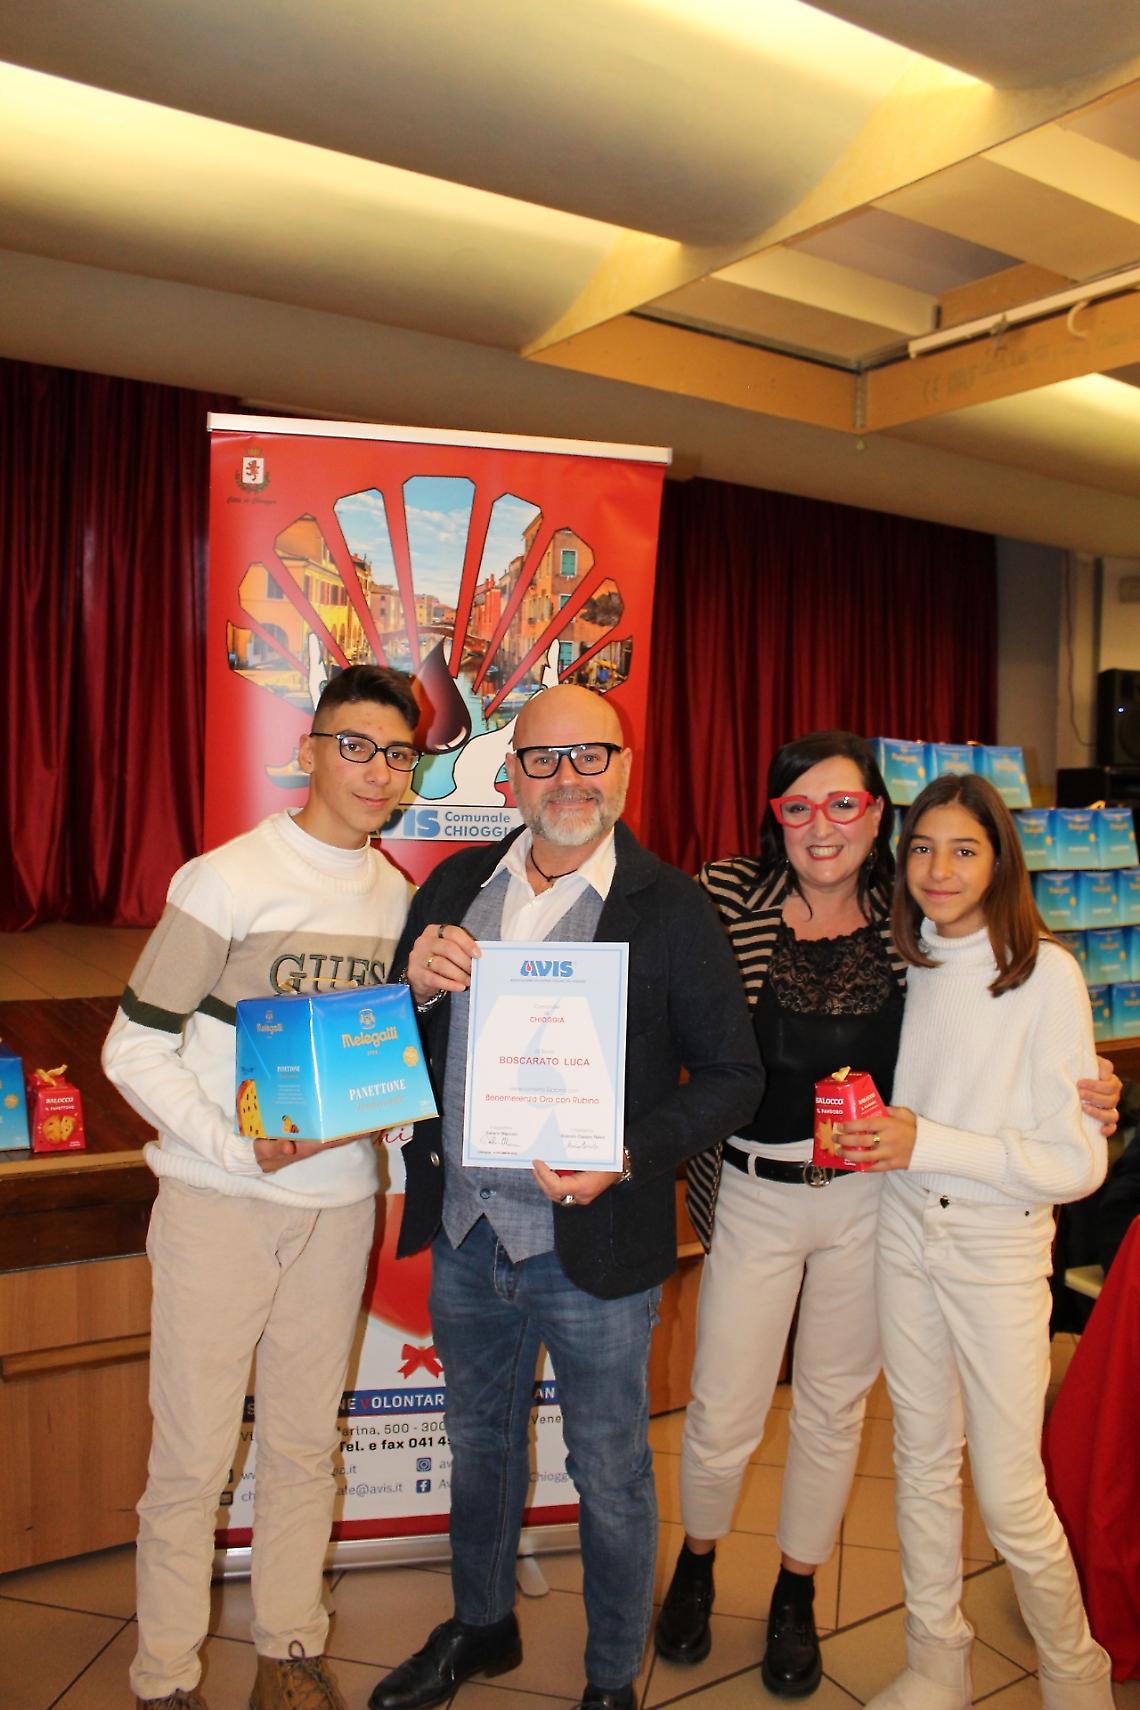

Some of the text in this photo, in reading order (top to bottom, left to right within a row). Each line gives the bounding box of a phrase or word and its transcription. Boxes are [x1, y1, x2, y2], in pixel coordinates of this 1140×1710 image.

[444, 811, 511, 823] Comunale
[270, 953, 386, 994] GUES
[520, 960, 574, 978] AVIS
[341, 1027, 398, 1048] Melegatti
[499, 1056, 591, 1066] BOSCARATO LUCA
[348, 1079, 407, 1101] PANETTONE
[362, 1393, 445, 1410] VOLONTAR
[337, 1424, 380, 1437] arina.
[384, 1423, 410, 1435] 500
[421, 1420, 445, 1432] 300
[531, 1415, 562, 1425] Vene
[340, 1440, 364, 1452] Tel.
[369, 1441, 377, 1451] e
[382, 1439, 404, 1450] fax
[409, 1436, 433, 1449] 041
